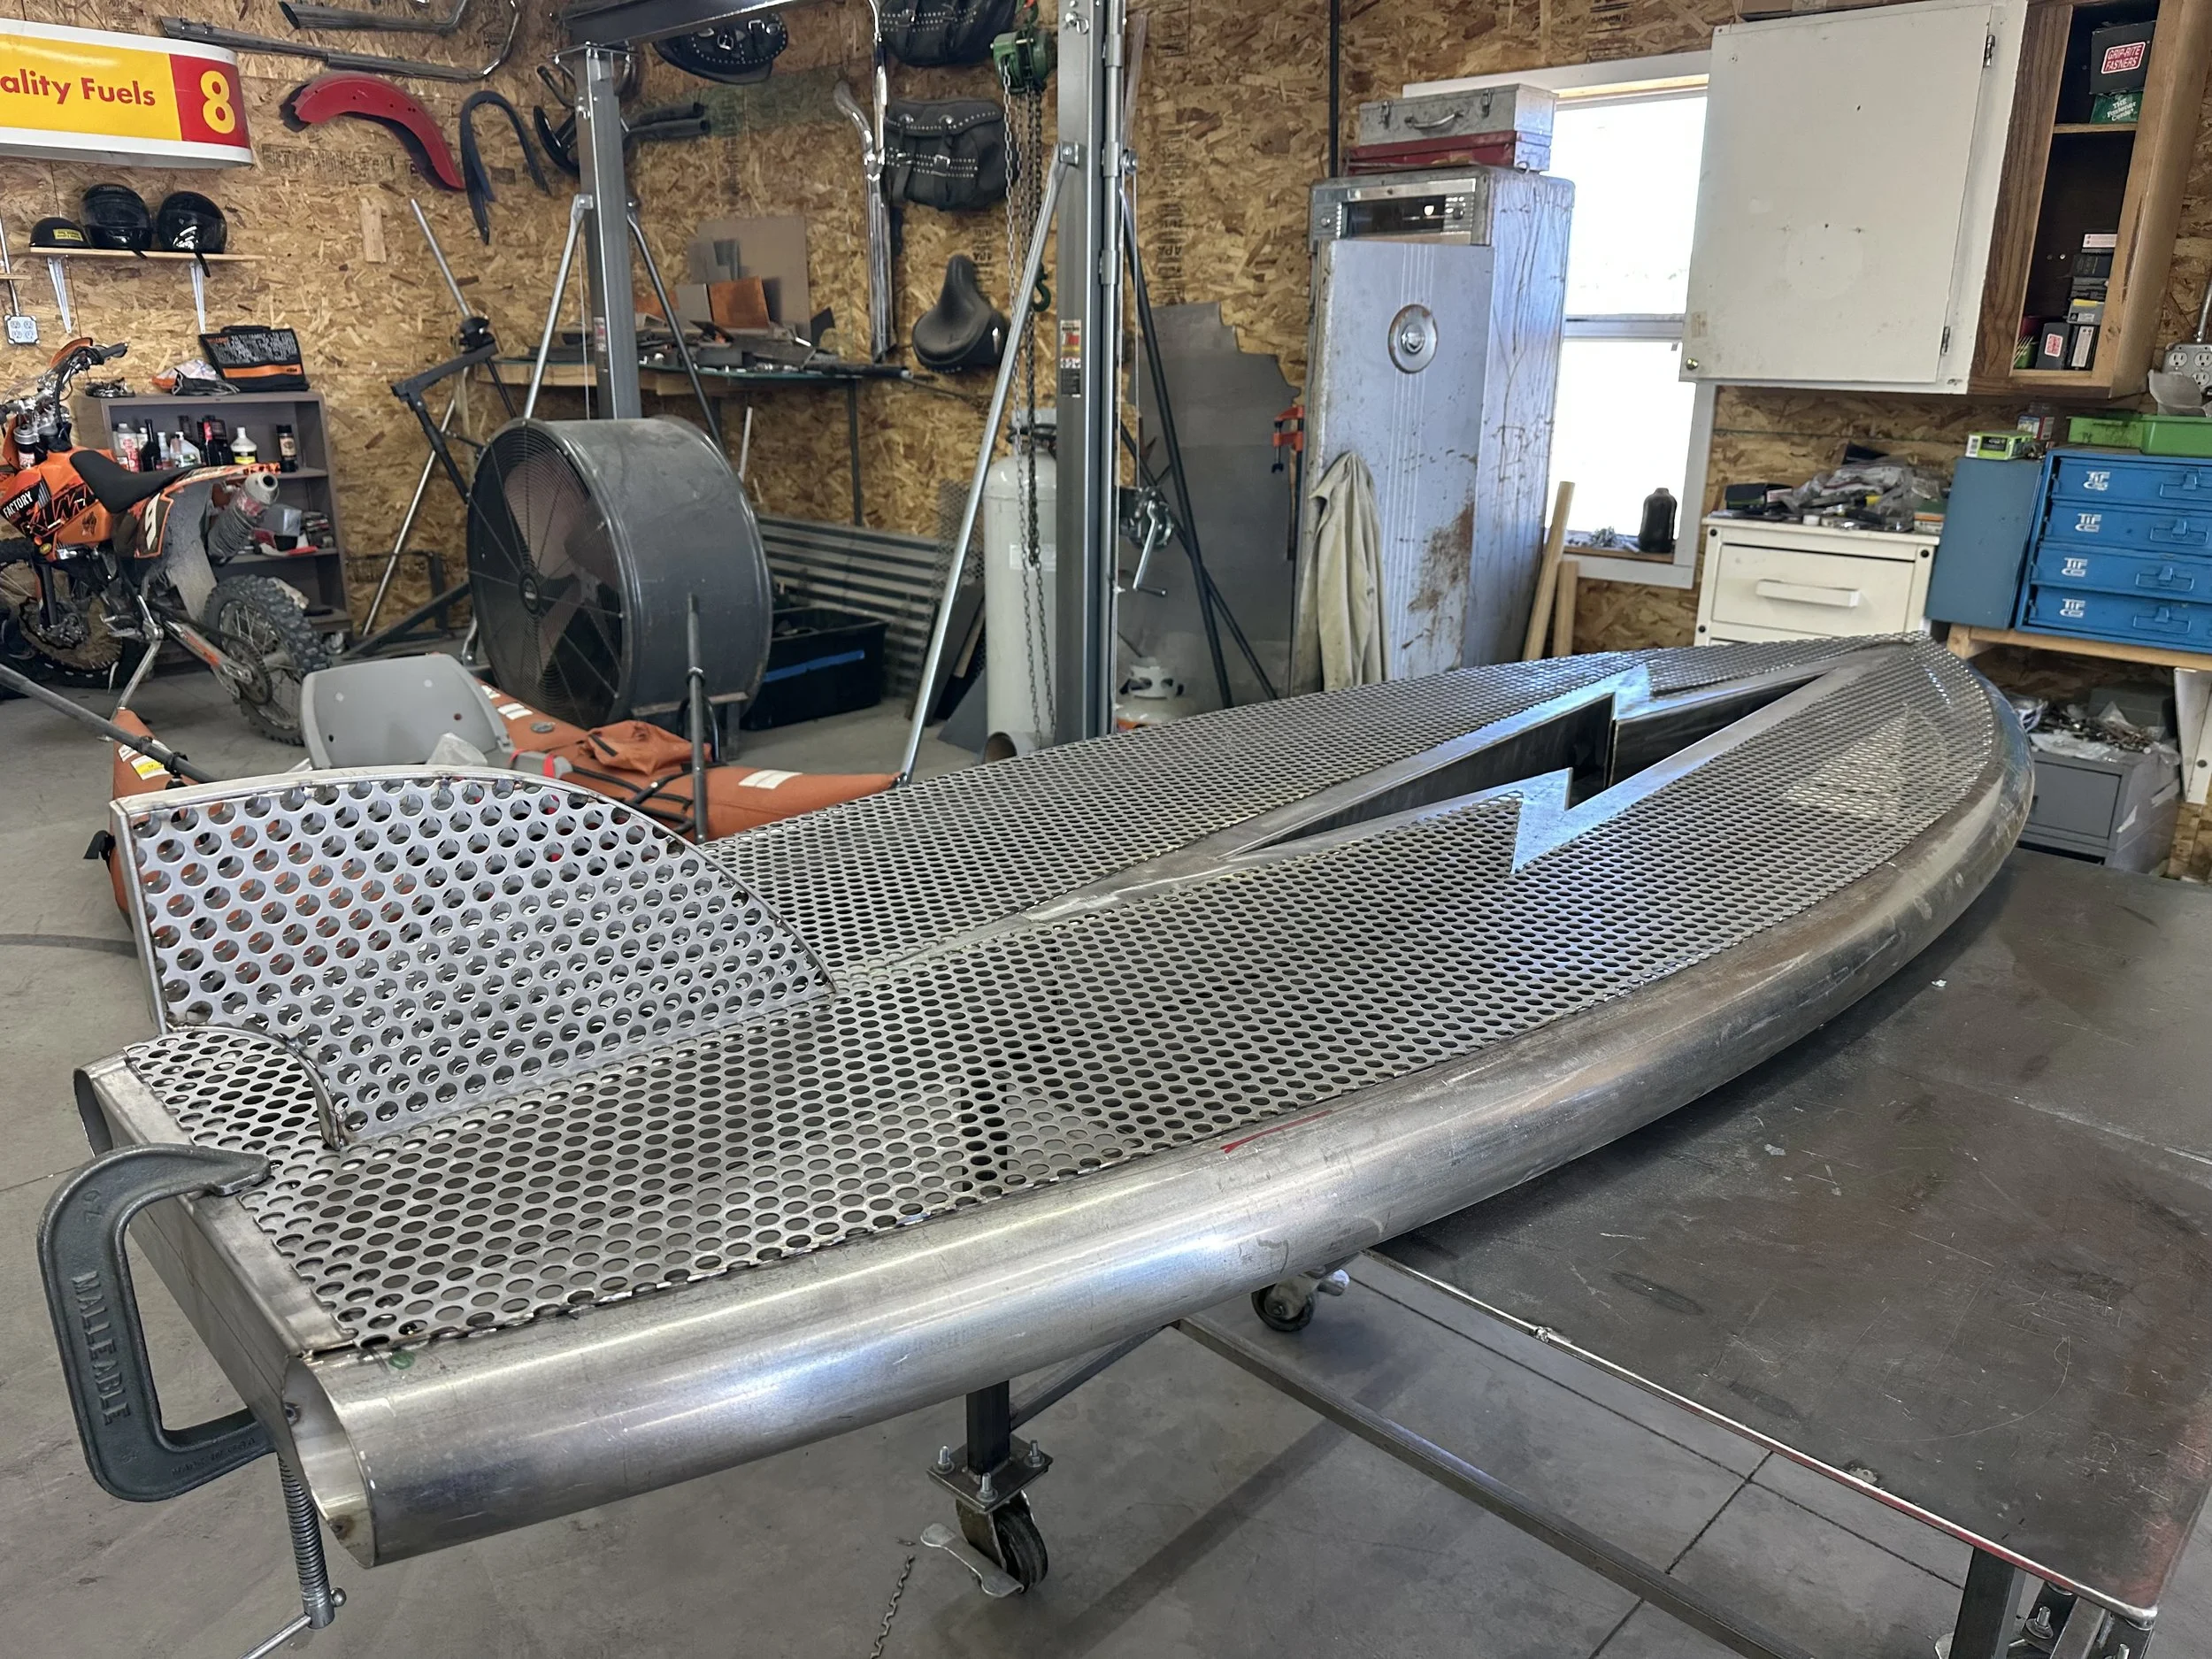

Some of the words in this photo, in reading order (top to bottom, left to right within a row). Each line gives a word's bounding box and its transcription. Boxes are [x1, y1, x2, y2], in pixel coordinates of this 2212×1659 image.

[2108, 45, 2142, 60] GRIP-RITE
[0, 68, 71, 104] ality
[81, 77, 156, 106] Fuels
[200, 70, 235, 134] 8
[3, 490, 34, 518] FACTORY
[71, 1271, 131, 1425] MALLEABLE
